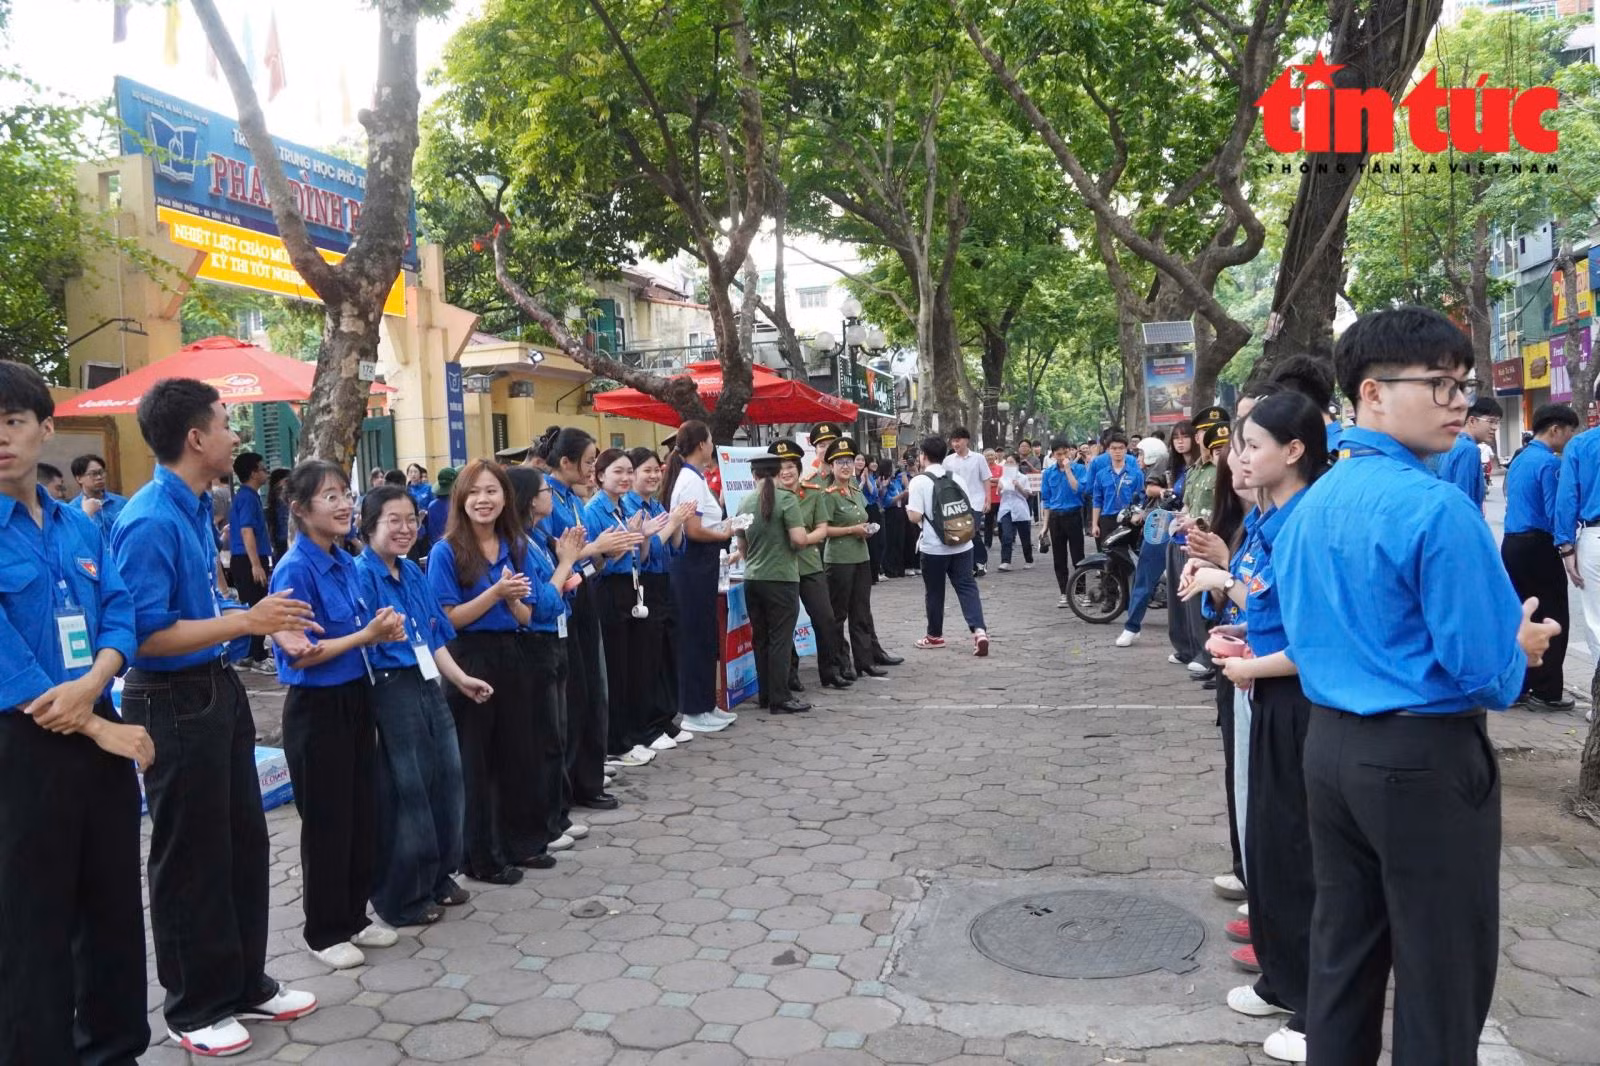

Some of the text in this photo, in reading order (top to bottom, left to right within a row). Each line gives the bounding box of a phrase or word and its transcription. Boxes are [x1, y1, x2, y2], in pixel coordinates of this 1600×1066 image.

[279, 146, 311, 169] TRUNG
[313, 158, 335, 178] HỌC
[208, 153, 272, 209] PHA
[174, 222, 211, 245] NHIỆT
[213, 232, 237, 252] LIỆT
[239, 239, 270, 259] CHÀO
[230, 256, 249, 274] THI
[941, 499, 968, 516] VANS
